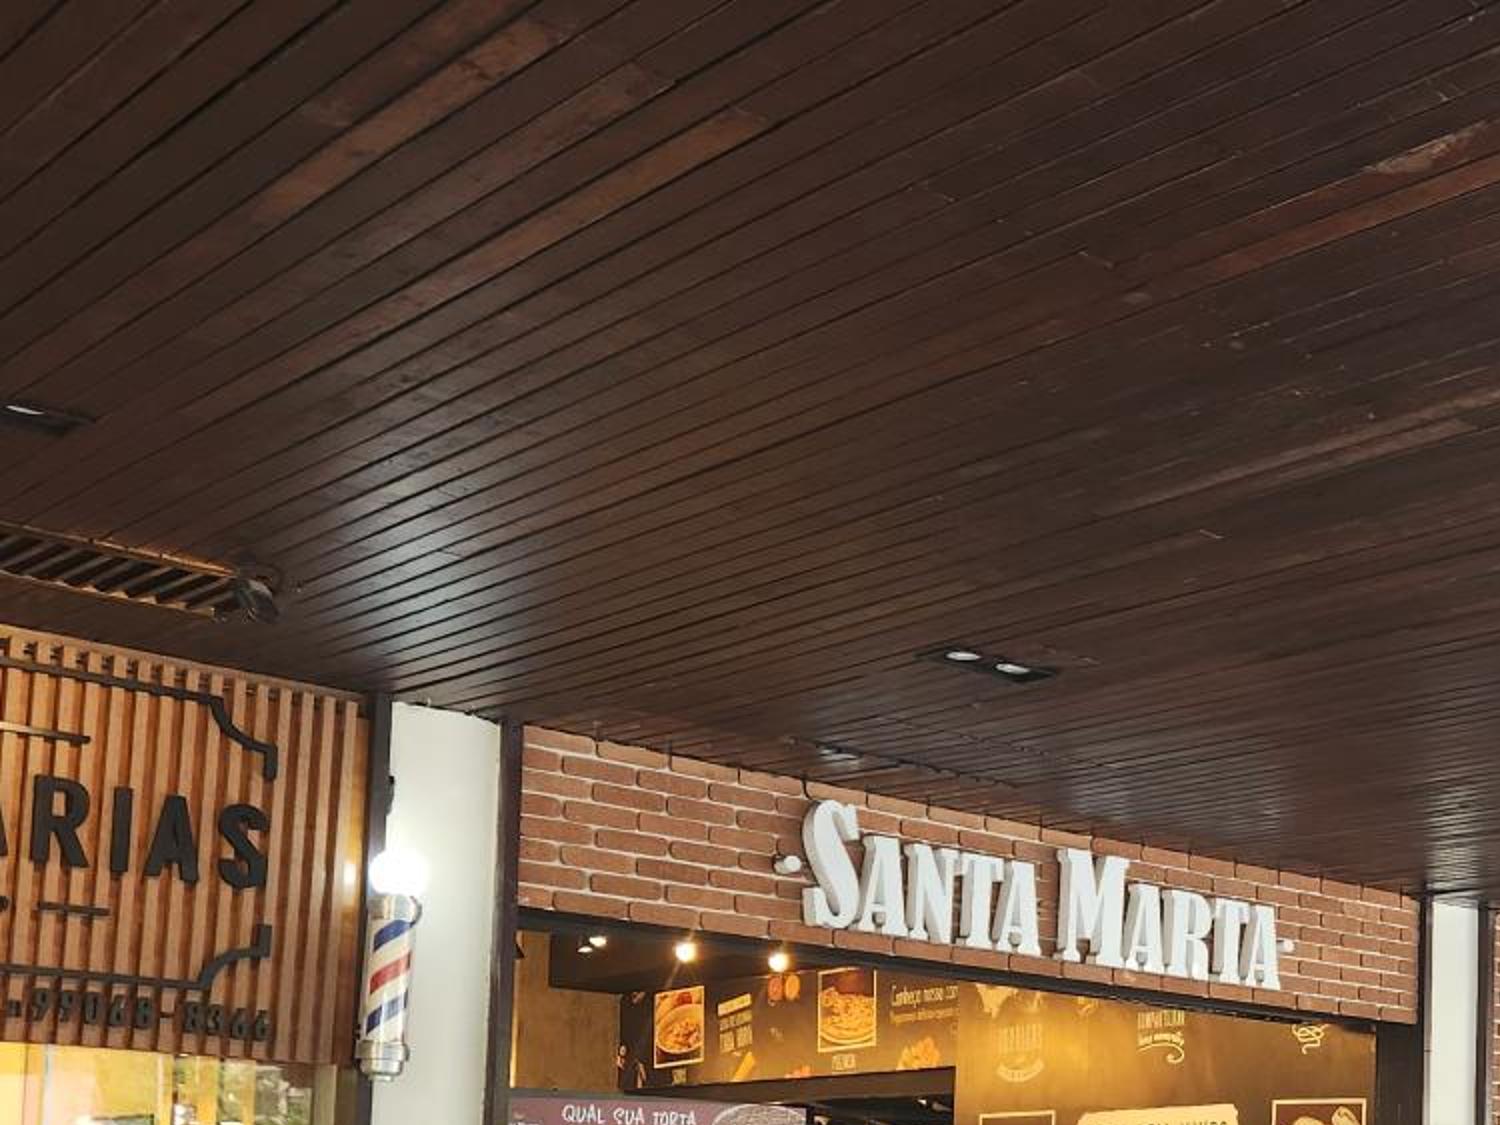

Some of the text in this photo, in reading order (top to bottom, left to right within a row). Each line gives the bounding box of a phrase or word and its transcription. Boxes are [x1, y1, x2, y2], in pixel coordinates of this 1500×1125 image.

[0, 774, 270, 890] RIAS
[801, 799, 1281, 990] SANTA MARTA
[562, 1104, 606, 1124] QUAL
